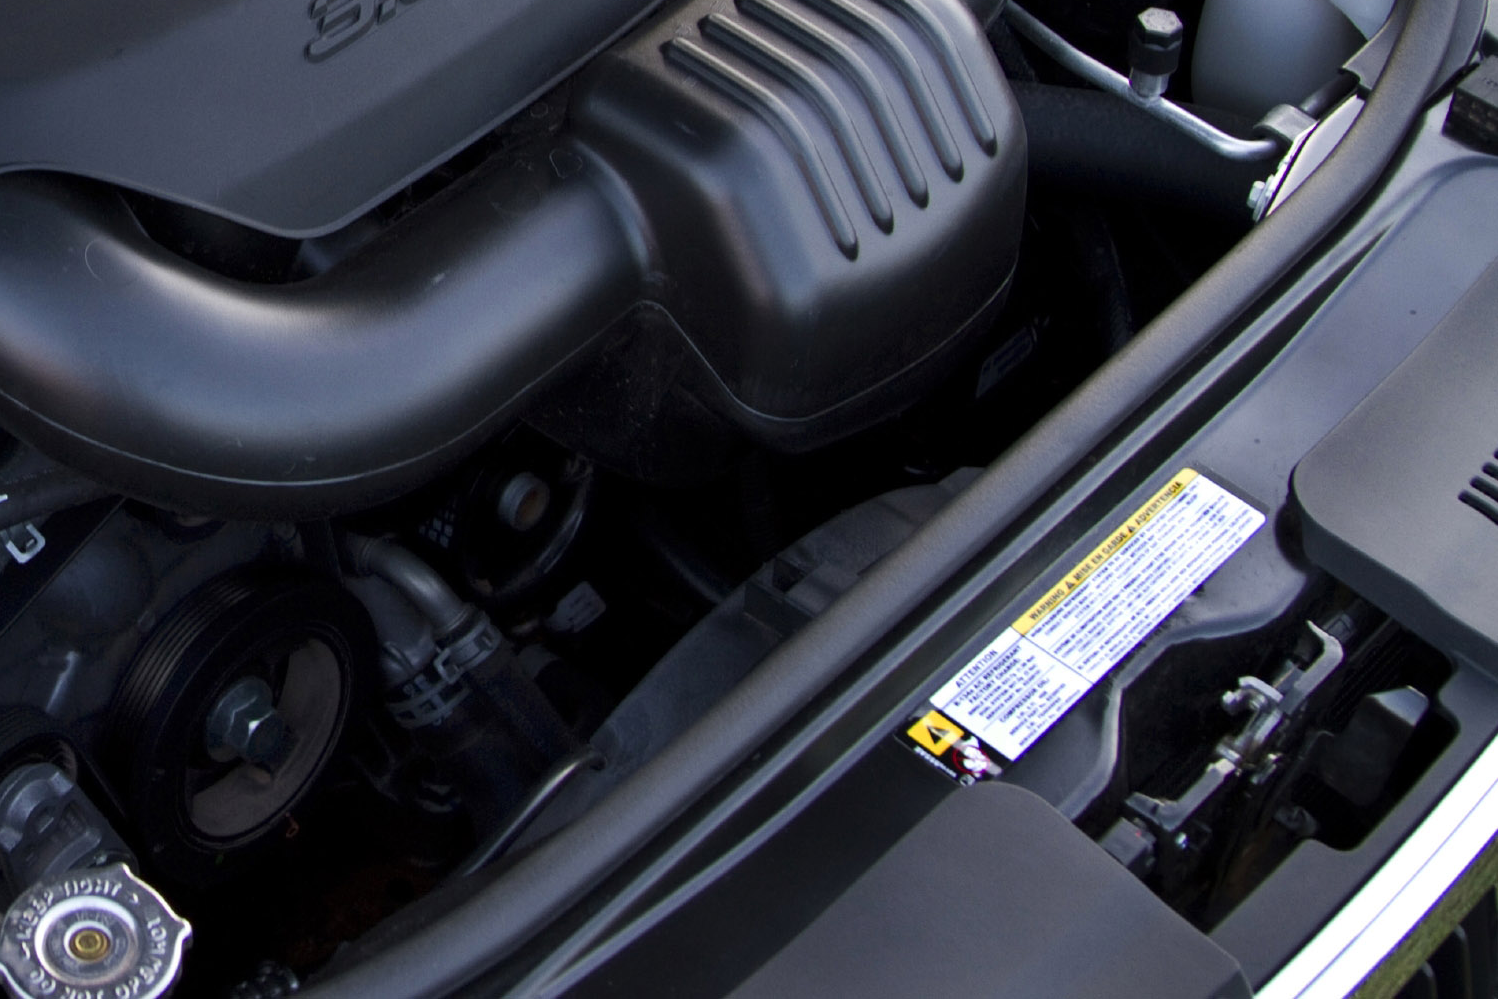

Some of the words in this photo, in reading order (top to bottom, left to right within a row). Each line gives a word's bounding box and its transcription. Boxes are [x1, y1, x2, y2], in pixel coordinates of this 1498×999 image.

[1133, 481, 1183, 525] ADVERTENCIA
[1073, 563, 1093, 580] MISE
[1091, 553, 1103, 564] EN
[1101, 532, 1127, 554] GARDE
[1029, 588, 1065, 620] WARNING
[954, 649, 998, 688] ATTENTION
[983, 645, 1021, 680] REFRIGERANT
[969, 680, 996, 704] FACTORY
[63, 877, 123, 897] TIGHT
